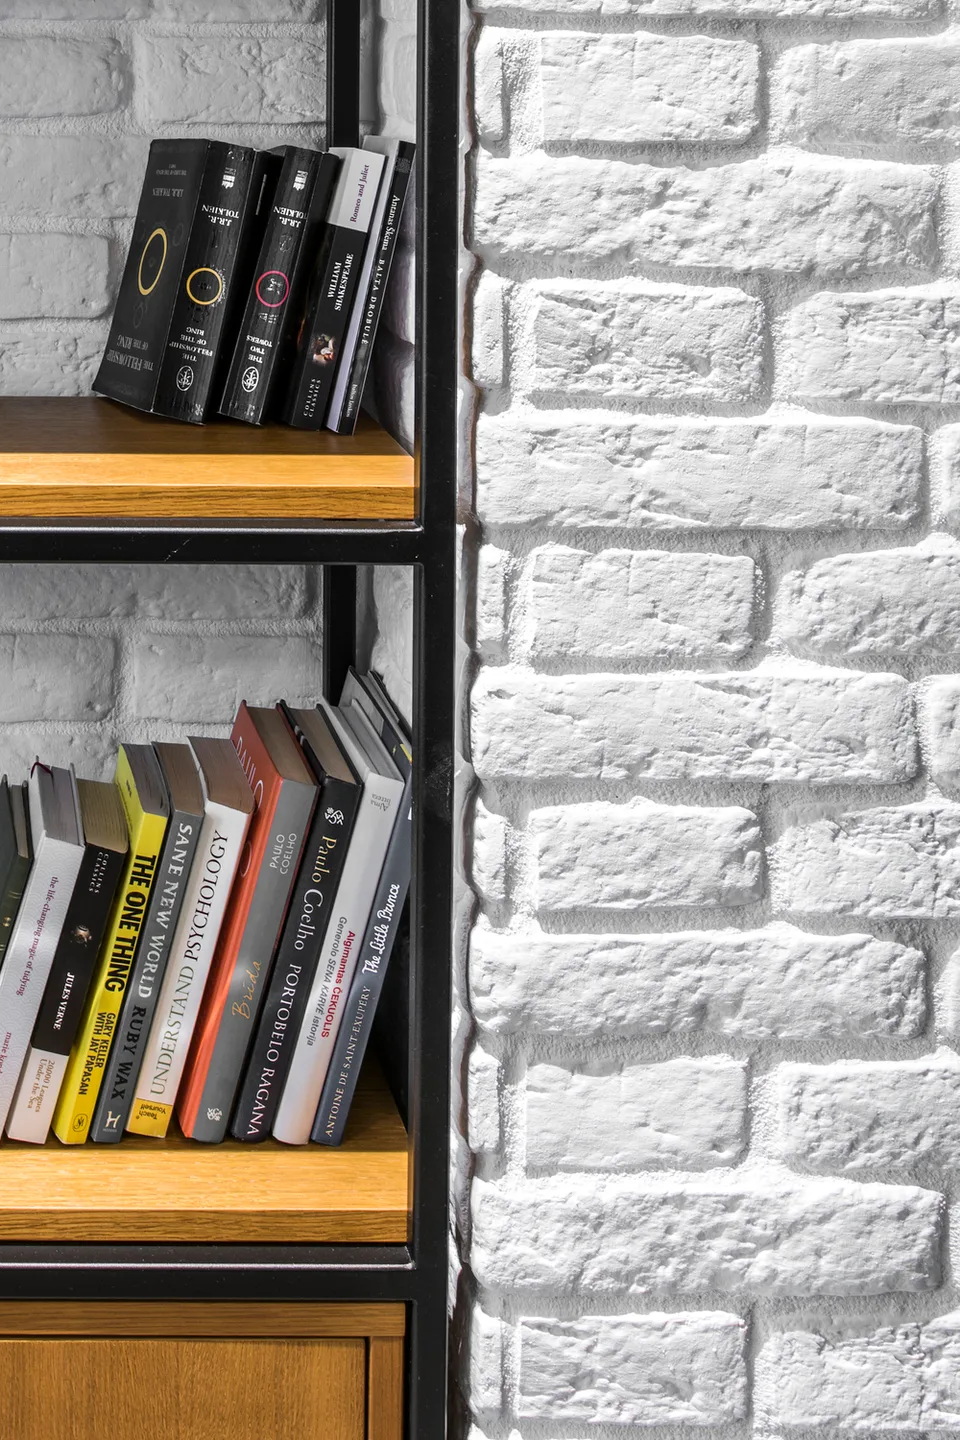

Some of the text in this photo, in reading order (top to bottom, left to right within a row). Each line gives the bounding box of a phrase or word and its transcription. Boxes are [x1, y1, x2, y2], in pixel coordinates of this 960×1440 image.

[202, 204, 240, 218] TOLKIEN
[273, 206, 308, 220] TOLKIEN
[350, 198, 362, 222] Romeo
[360, 164, 370, 184] Juliet
[388, 194, 401, 225] Antanas
[208, 215, 233, 226] J.R.R.
[279, 216, 302, 228] J.R.R.
[328, 262, 342, 298] WILLIAM
[334, 253, 354, 312] SHAKESPEARE
[372, 259, 385, 291] BALTA
[180, 334, 207, 346] OF THE
[186, 326, 204, 336] RING
[361, 296, 378, 345] DROBULĖ
[169, 341, 214, 357] FELLOWSHIP
[182, 352, 198, 362] THE
[246, 334, 272, 348] TOWERS
[248, 354, 262, 364] THE
[250, 346, 265, 354] TWO
[303, 378, 316, 416] COLLINS
[308, 380, 321, 418] CLASSICS
[270, 834, 286, 869] PAULO
[280, 833, 297, 874] COELHO
[89, 852, 104, 892] CLASSICS
[95, 854, 110, 894] COLLINS
[16, 876, 58, 996] the life-changing magic of tidying
[104, 855, 157, 993] THE ONE THING
[362, 883, 400, 974] The Little Prince
[111, 822, 192, 1100] SANE NEW WORLD RUBY WAX
[150, 830, 228, 1095] UNDERSTAND PSYCHOLOGY
[54, 972, 74, 1030] JULES VERNE
[232, 960, 262, 1019] Brida
[246, 836, 337, 1136] Paulo Coelho PORTOBELO RAGANA
[306, 916, 347, 1047] Generolo SENA KARVĖ istorija
[321, 930, 356, 1038] Algimantas ČEKUOLIS
[2, 1032, 12, 1055] marie
[78, 1012, 106, 1096] WITH JAY PAPASAN
[96, 1013, 116, 1068] GARY KELLER
[325, 986, 372, 1138] ANTOINE DE SAINT-EXUPÉRY
[28, 1058, 48, 1108] Under the Sea
